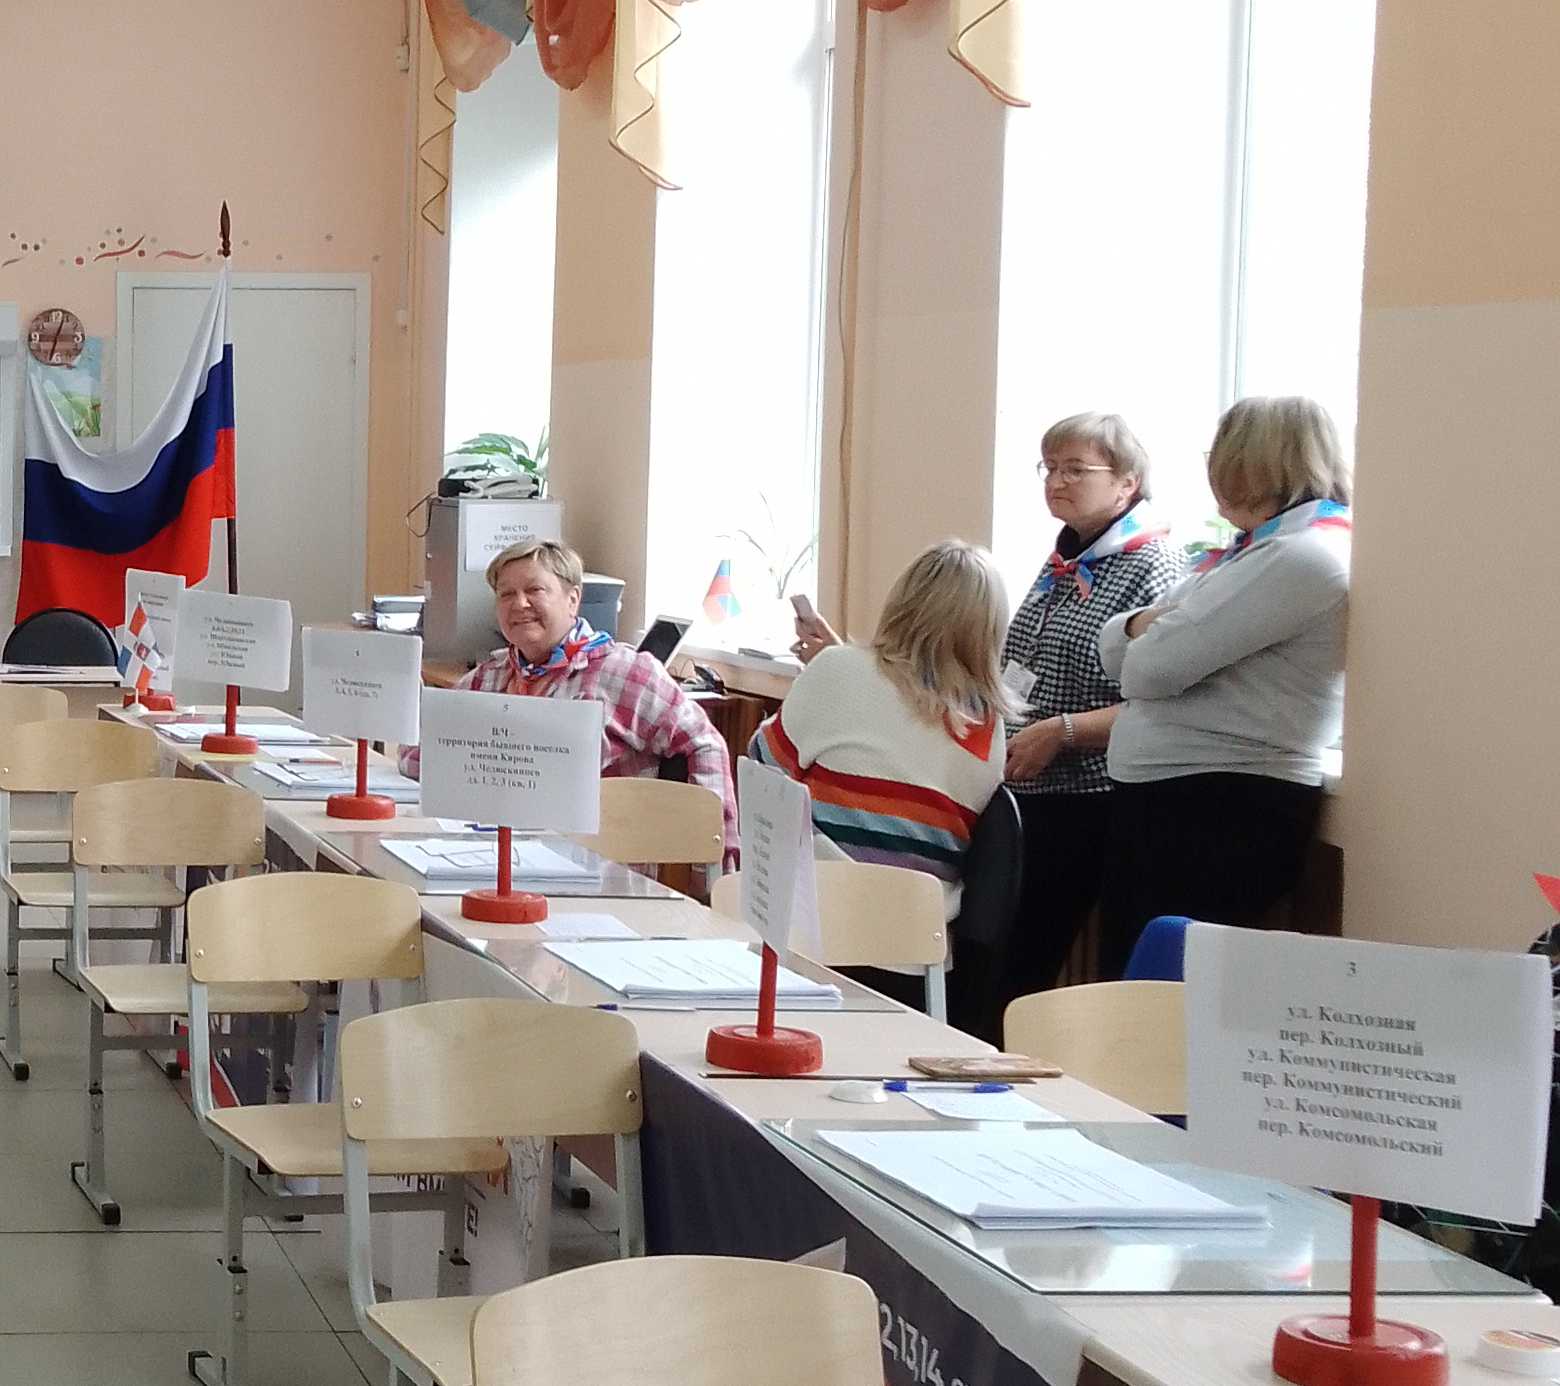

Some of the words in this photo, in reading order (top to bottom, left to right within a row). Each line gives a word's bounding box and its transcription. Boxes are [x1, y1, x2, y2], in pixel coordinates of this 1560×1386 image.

[52, 310, 63, 322] 12
[31, 332, 40, 342] 9
[74, 332, 83, 343] 3
[53, 353, 61, 363] 6
[503, 704, 509, 712] 5
[437, 737, 489, 750] территория
[470, 752, 499, 761] имени
[500, 754, 534, 765] Кирова
[1347, 961, 1357, 977] 3
[1287, 1006, 1312, 1021] ул.
[1318, 1005, 1416, 1032] Колхозная
[1279, 1028, 1315, 1046] пер.
[1320, 1030, 1424, 1057] Колхозный
[1247, 1047, 1273, 1063] ул.
[1279, 1048, 1457, 1086] Коммунистическая
[1241, 1069, 1277, 1088] пер.
[1283, 1072, 1463, 1110] Коммунистический
[1264, 1096, 1289, 1111] ул.
[1295, 1097, 1438, 1132] Комсомольская
[1258, 1118, 1293, 1137] пер.
[1298, 1120, 1444, 1158] Комсомольский
